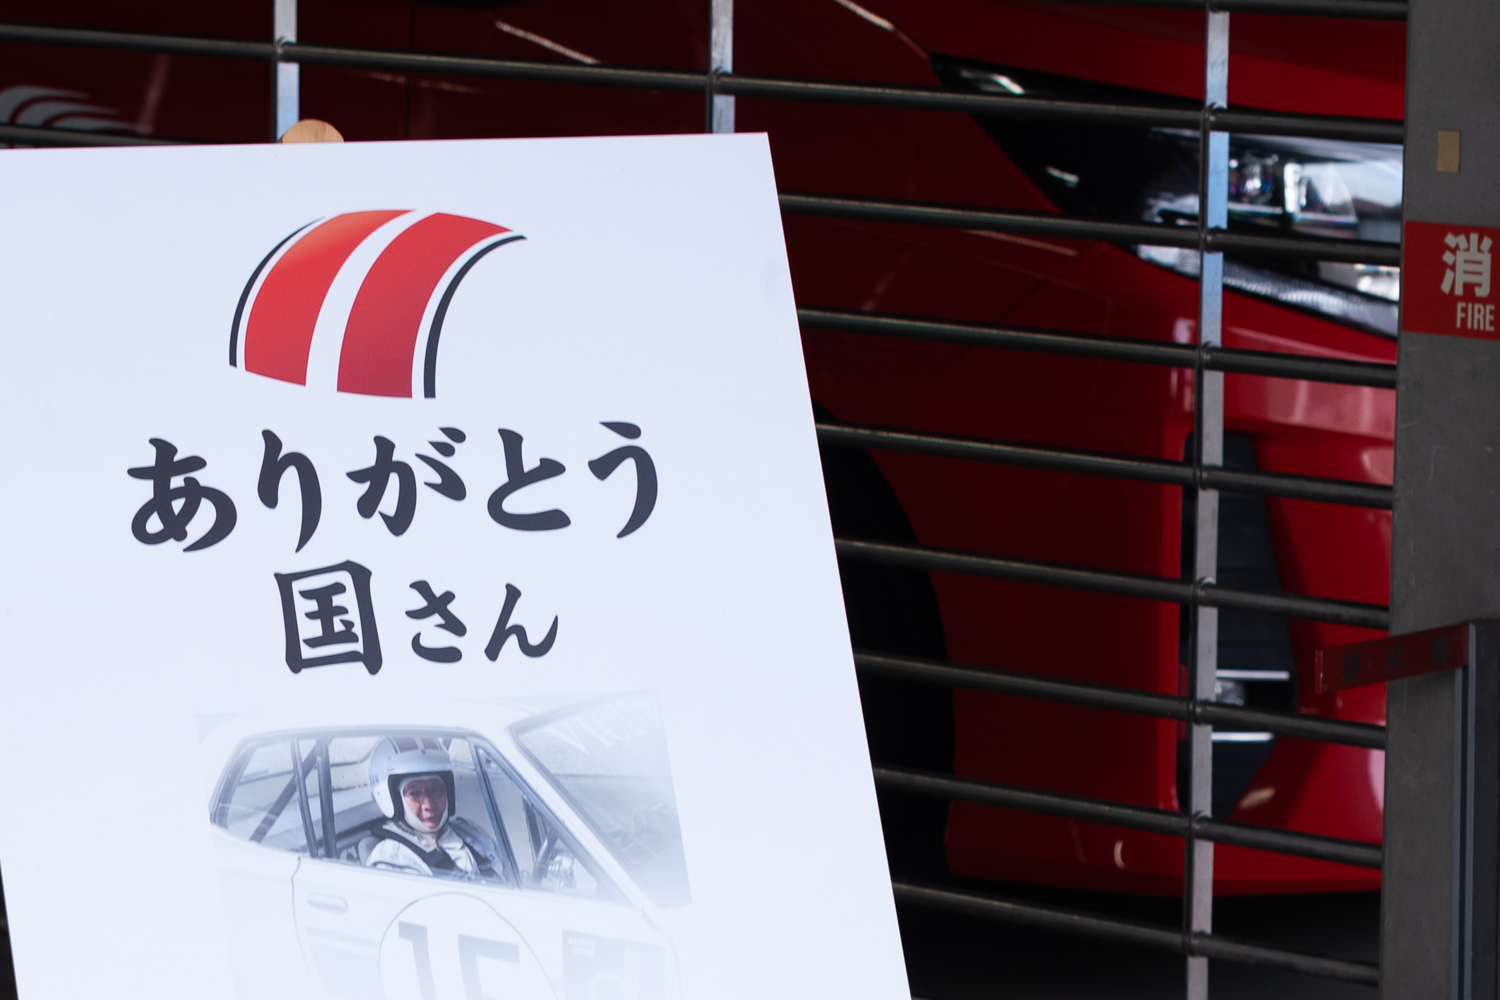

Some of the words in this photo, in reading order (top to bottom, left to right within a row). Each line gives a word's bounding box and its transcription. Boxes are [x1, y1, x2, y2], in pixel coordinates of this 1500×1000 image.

[1440, 232, 1493, 298] 消
[1455, 301, 1495, 332] FIRE
[126, 420, 659, 553] ありがとう
[273, 559, 559, 675] 国さん
